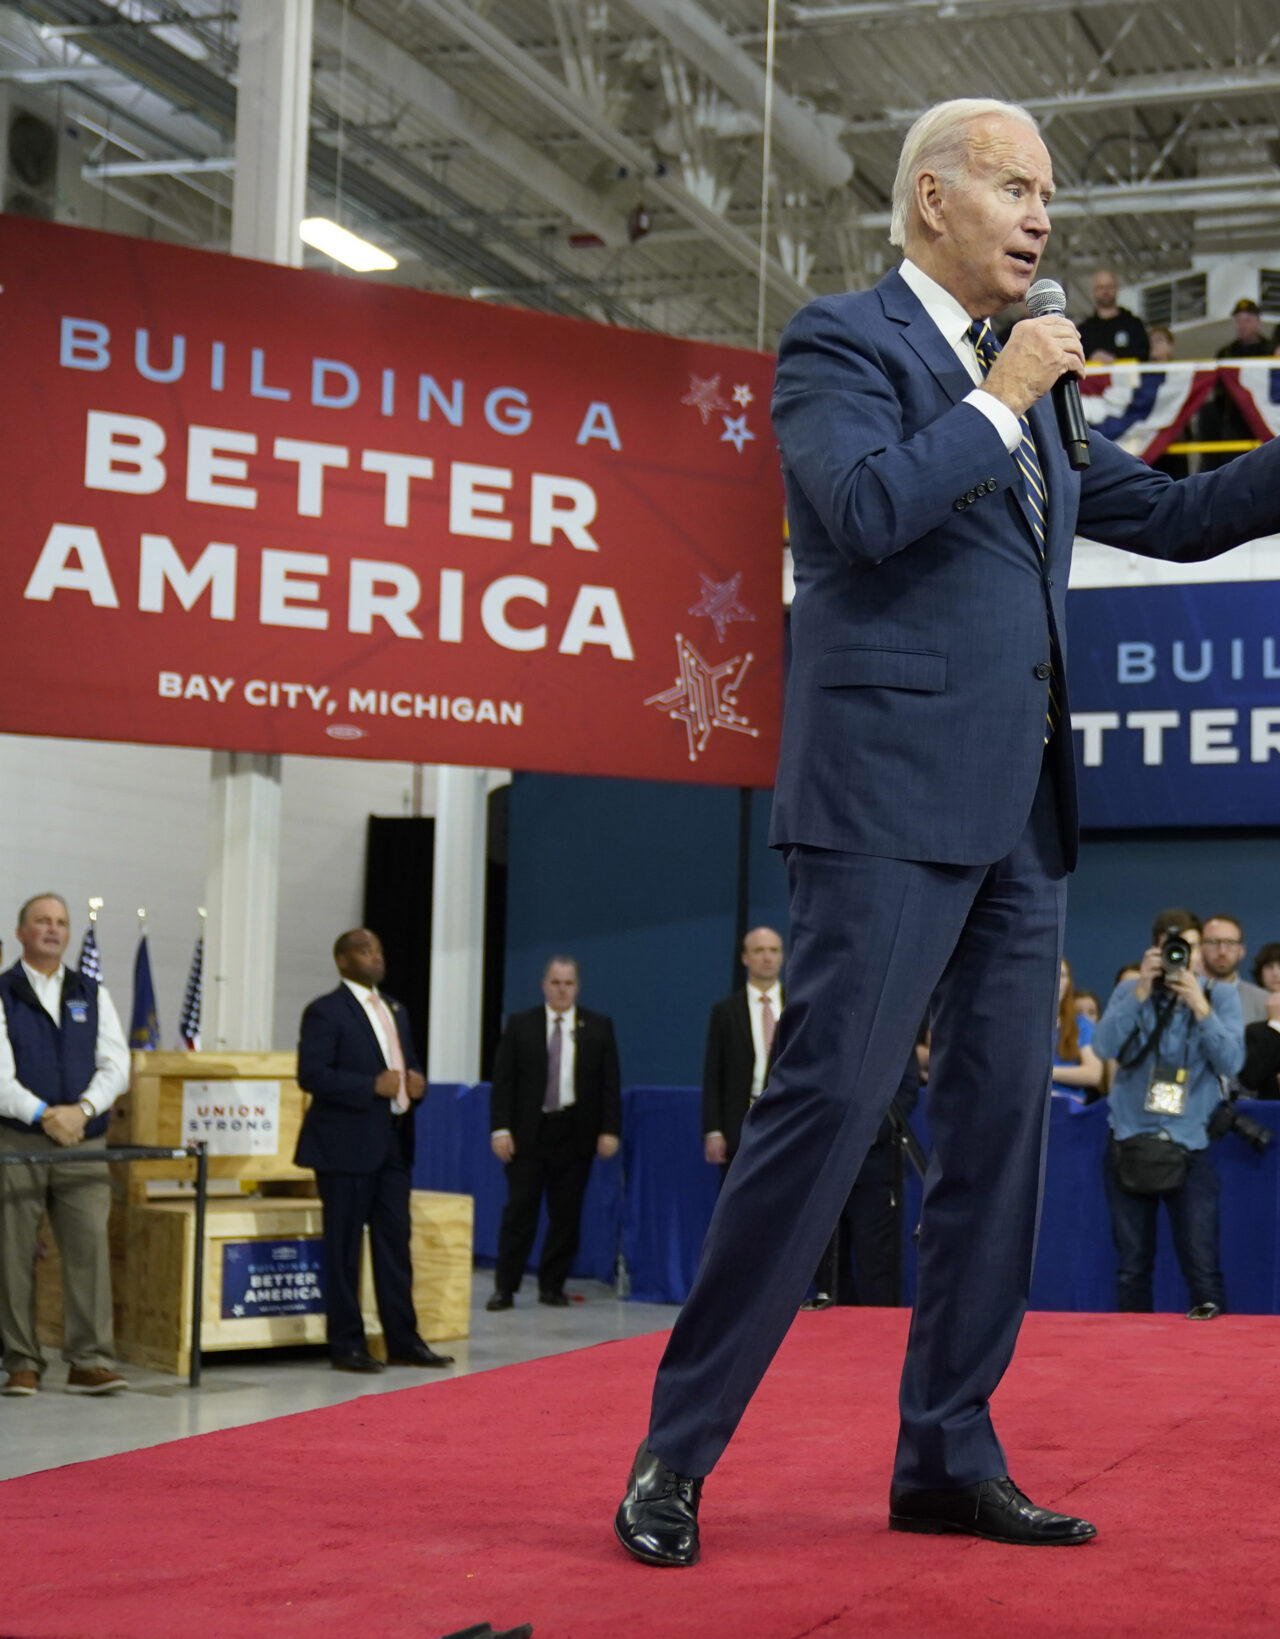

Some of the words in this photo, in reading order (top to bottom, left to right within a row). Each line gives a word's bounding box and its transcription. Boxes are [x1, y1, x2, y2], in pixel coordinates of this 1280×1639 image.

[60, 317, 532, 436] BUILDING
[576, 402, 622, 450] A
[84, 411, 599, 552] BETTER
[24, 523, 634, 660] AMERICA
[158, 671, 235, 702] BAY
[244, 680, 338, 715] CITY,
[348, 688, 523, 726] MICHIGAN
[189, 1120, 272, 1131] STRONG
[197, 1106, 265, 1117] UNION
[243, 1286, 322, 1303] AMERICA
[250, 1272, 317, 1288] BETTER
